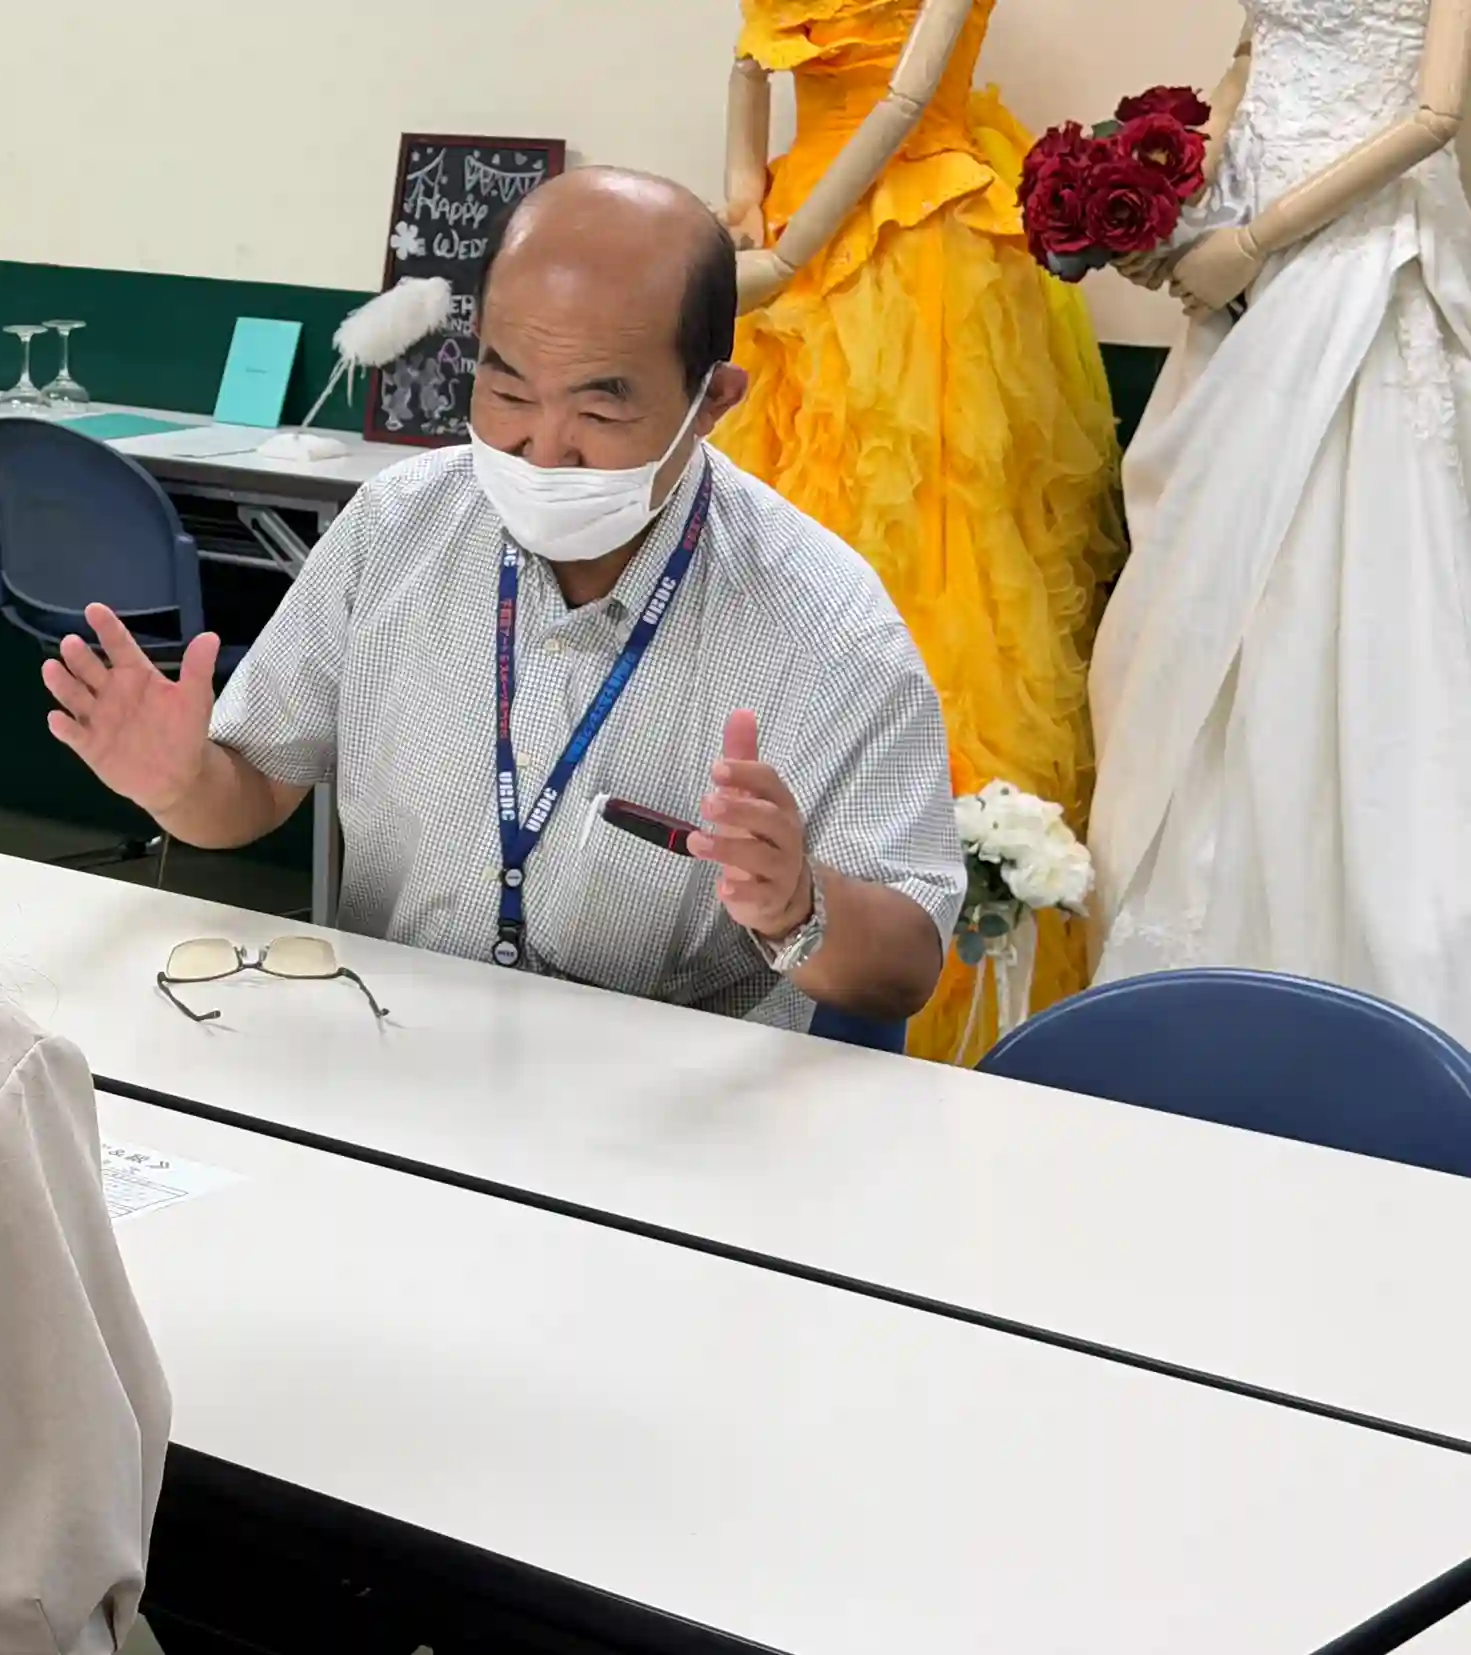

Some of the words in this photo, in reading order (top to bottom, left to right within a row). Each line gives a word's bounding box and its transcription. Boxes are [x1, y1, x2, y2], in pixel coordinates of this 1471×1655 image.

[642, 576, 677, 625] UBDC
[498, 771, 516, 821] UBDC
[525, 787, 558, 832] UBDC
